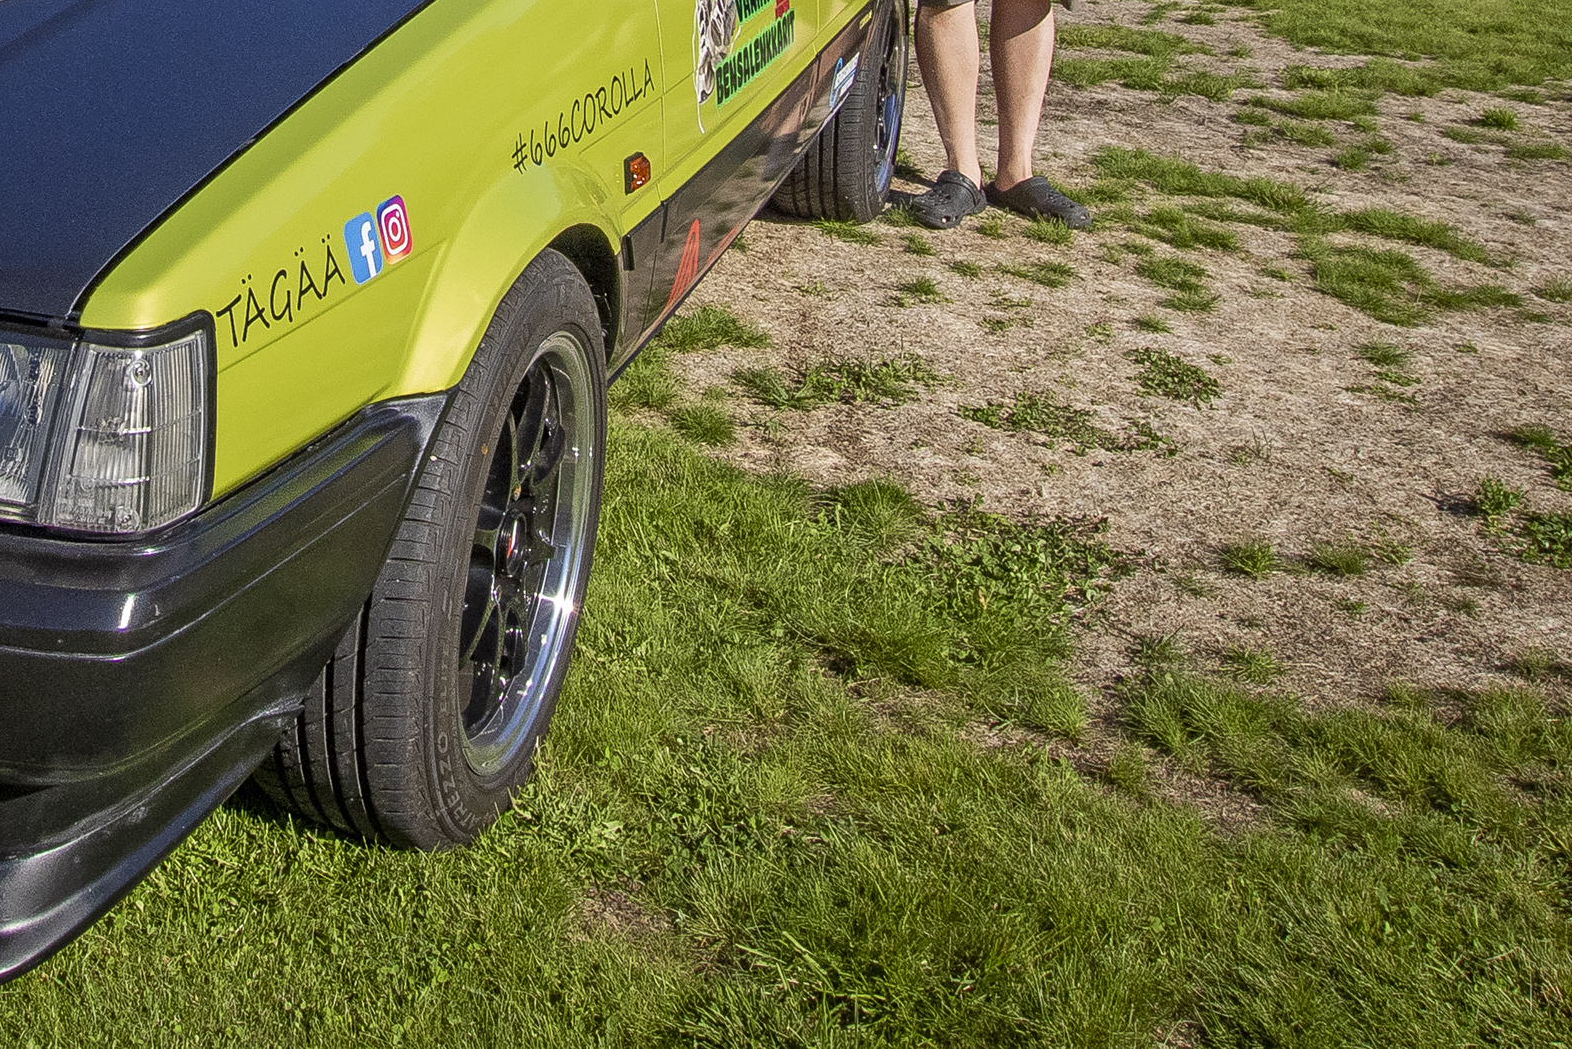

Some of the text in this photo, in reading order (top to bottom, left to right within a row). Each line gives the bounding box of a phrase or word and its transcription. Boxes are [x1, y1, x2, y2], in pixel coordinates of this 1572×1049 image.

[715, 10, 795, 106] BENSALENKKARIT
[511, 58, 655, 174] #666COROLLA
[216, 234, 346, 348] TÄGÄÄ
